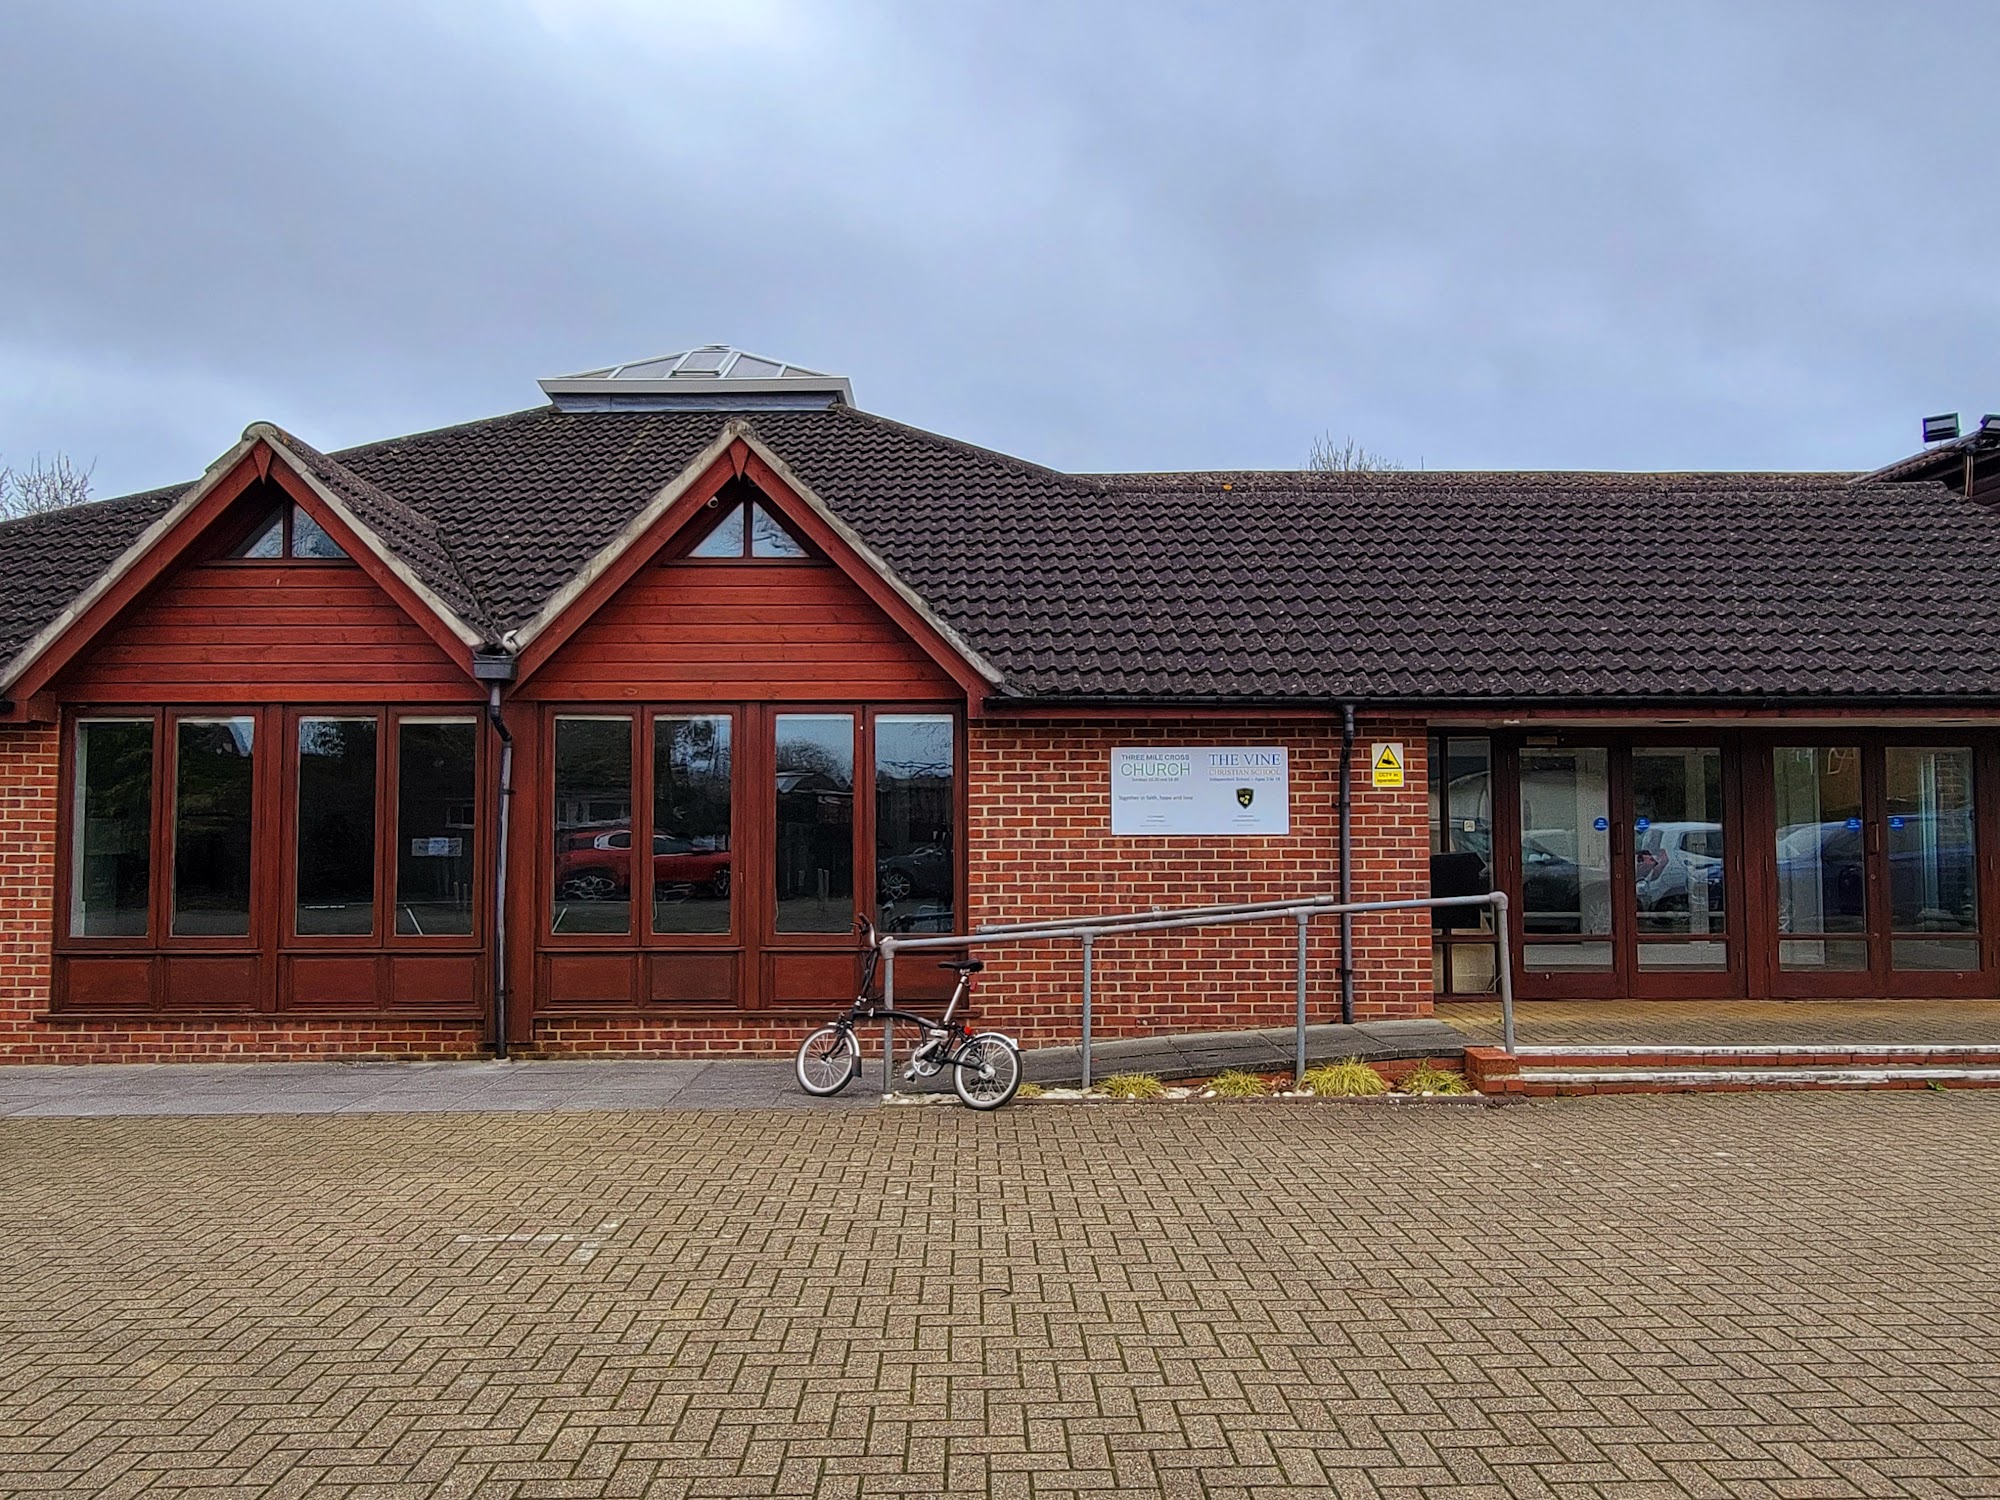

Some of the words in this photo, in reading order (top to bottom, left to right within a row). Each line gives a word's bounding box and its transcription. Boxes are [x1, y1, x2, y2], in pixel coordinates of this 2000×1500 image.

[1208, 754, 1239, 766] THE
[1244, 754, 1280, 766] VINE
[1121, 762, 1190, 776] CHURCH
